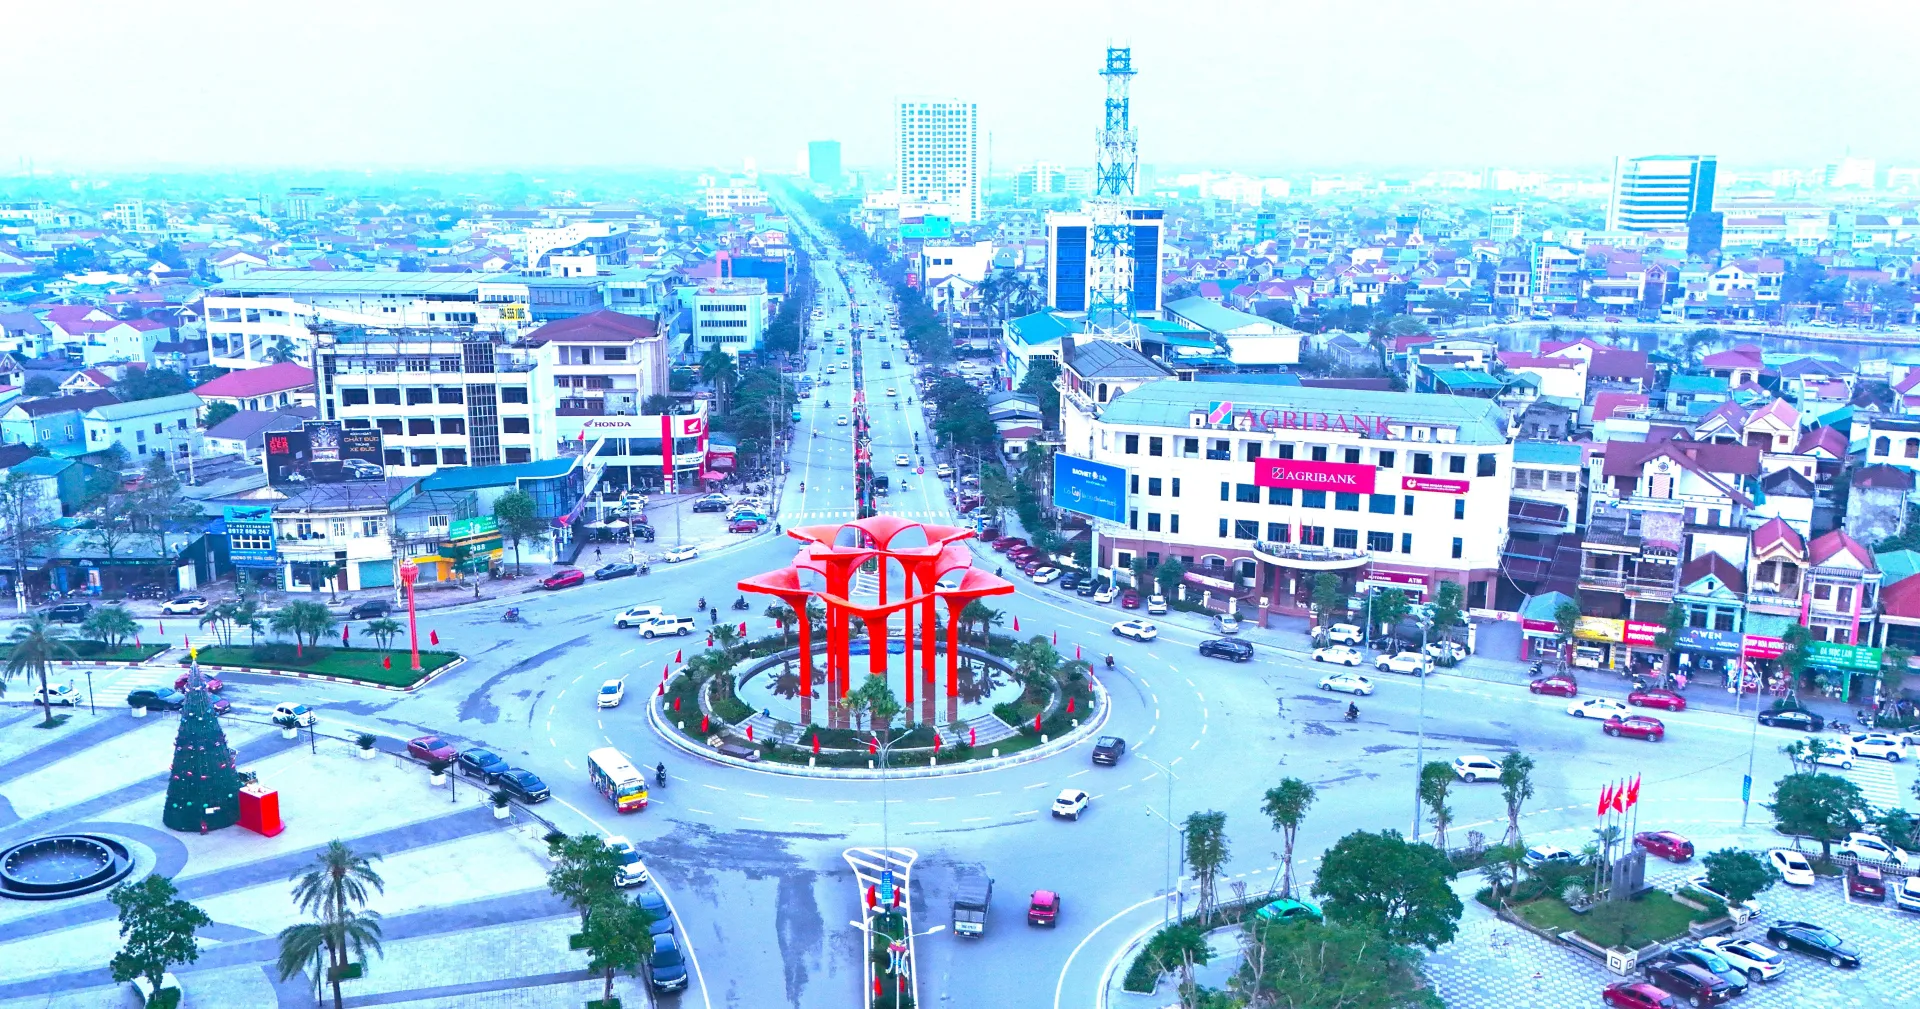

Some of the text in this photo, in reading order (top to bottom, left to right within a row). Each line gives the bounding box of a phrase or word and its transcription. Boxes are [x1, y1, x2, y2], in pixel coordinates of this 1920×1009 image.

[1240, 408, 1396, 436] AGRIBANK
[1286, 471, 1357, 485] AGRIBANK
[1691, 630, 1722, 640] OWEN
